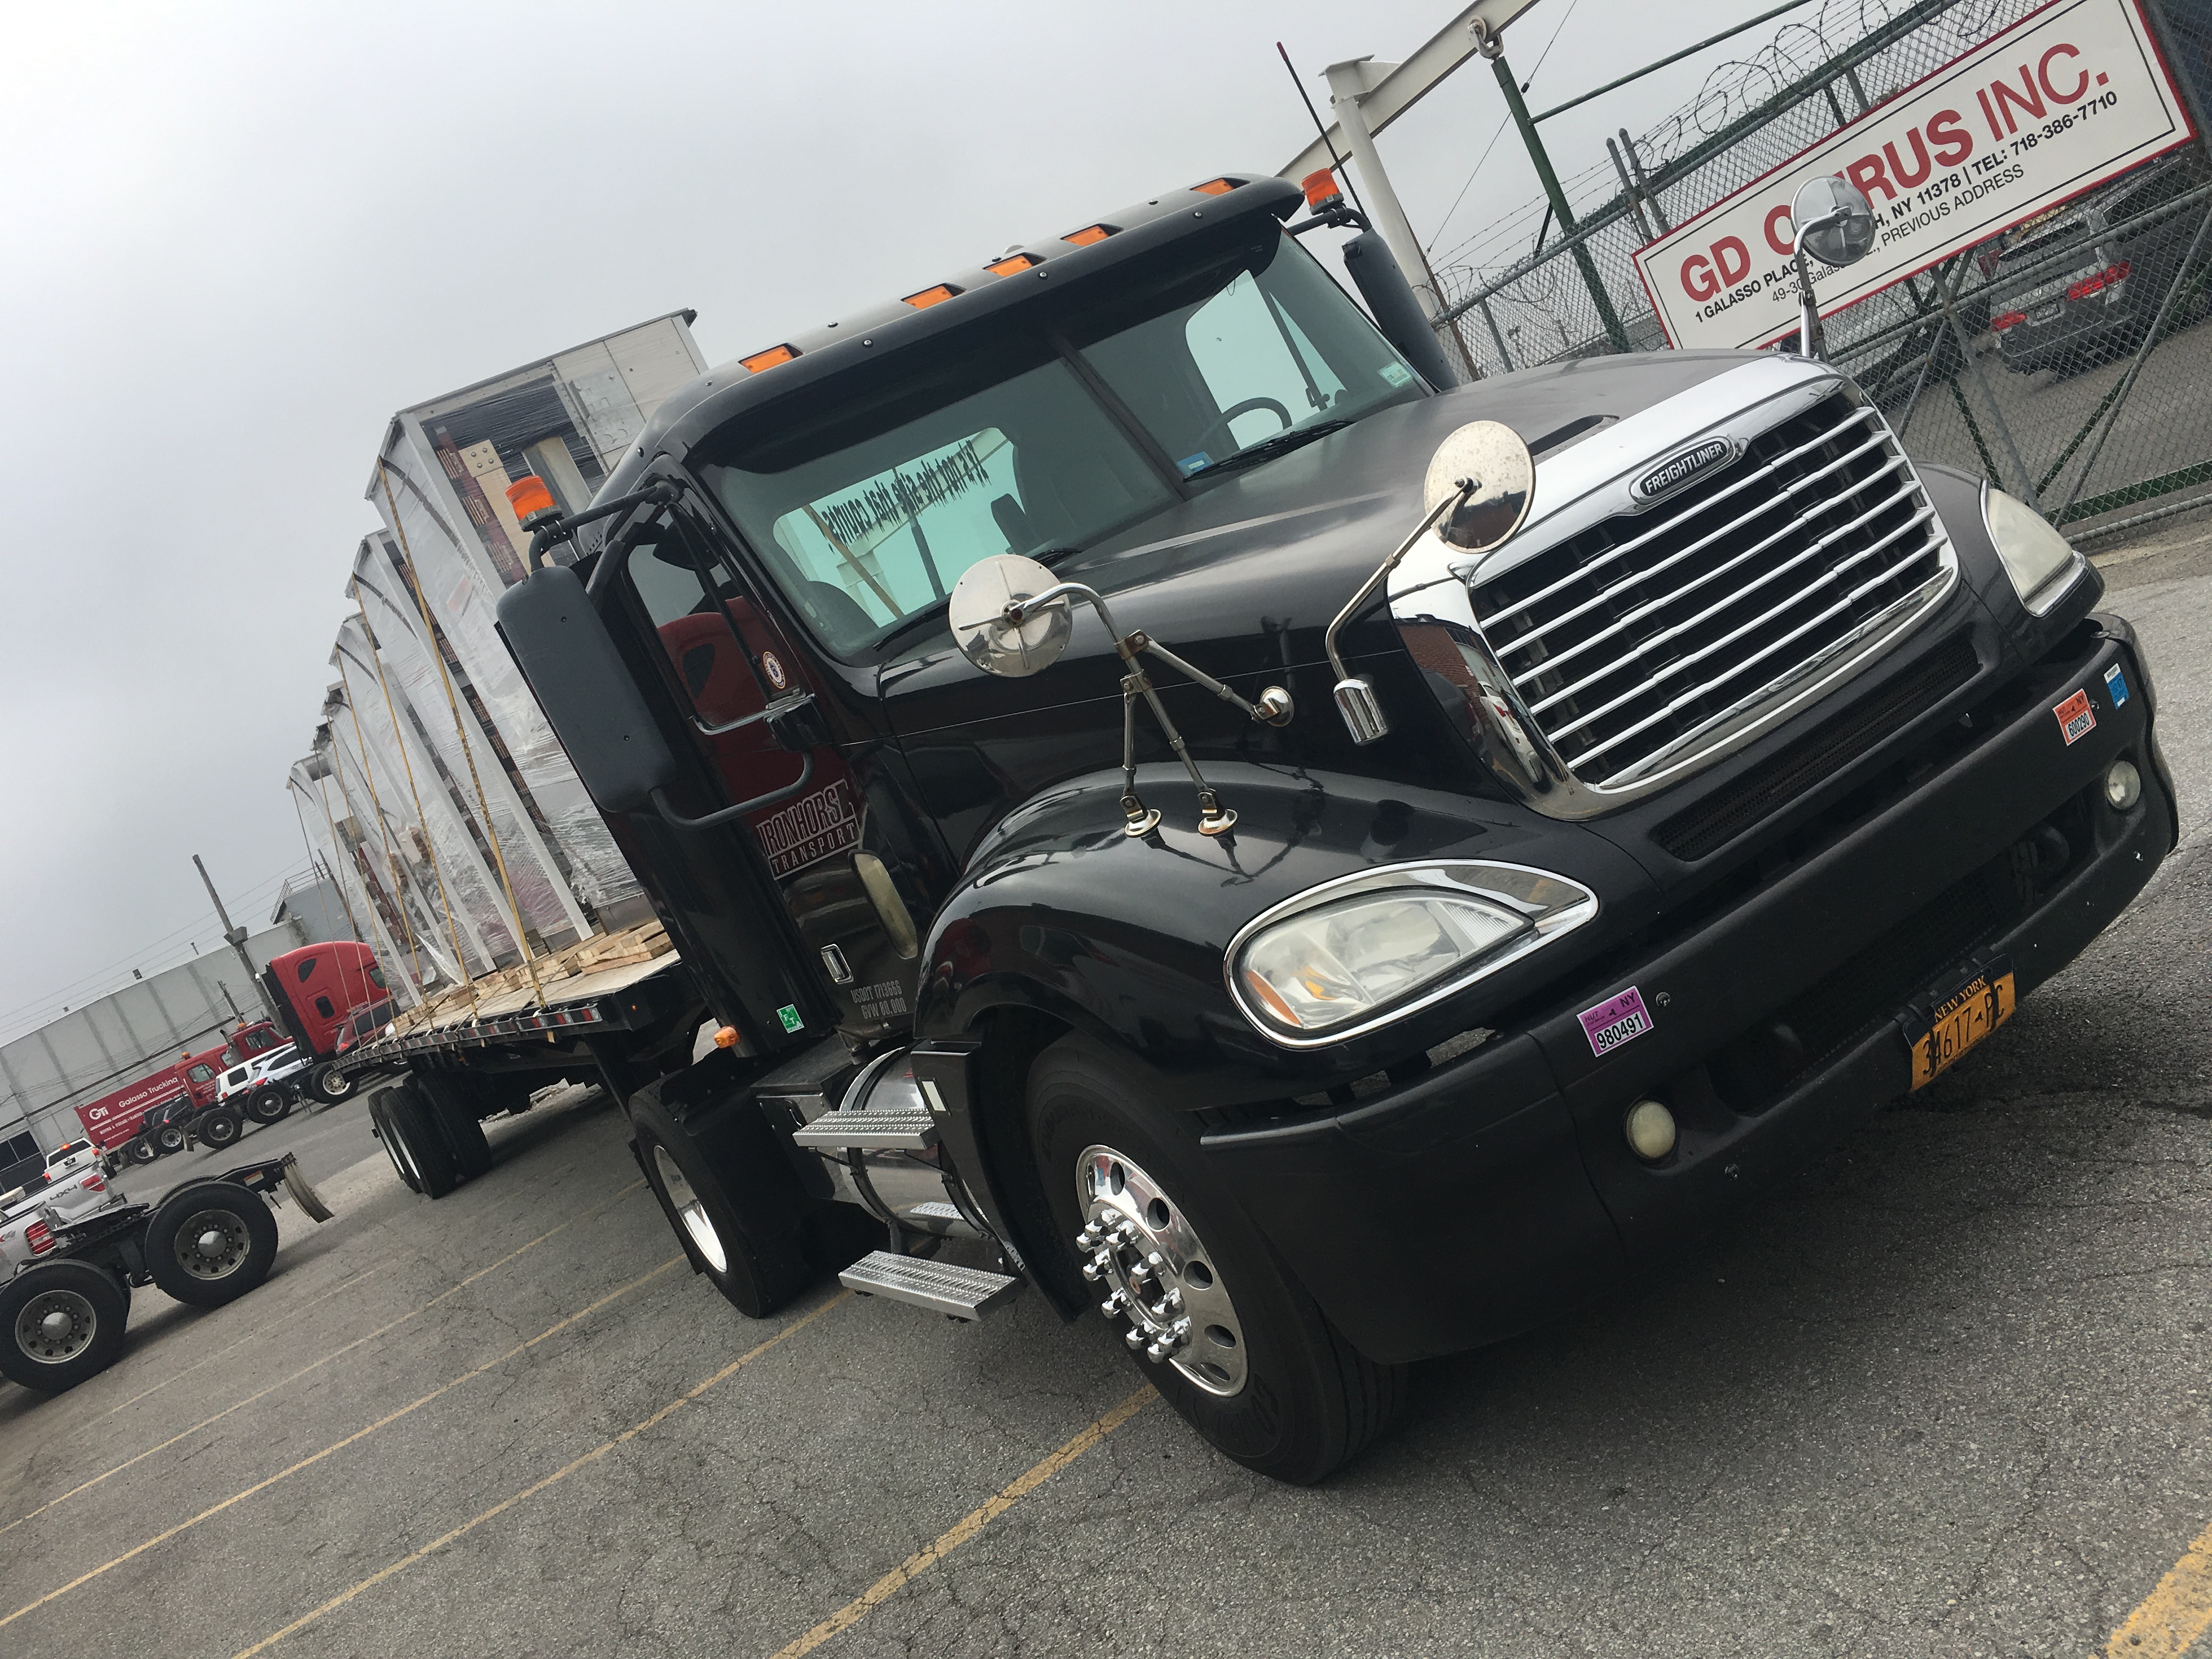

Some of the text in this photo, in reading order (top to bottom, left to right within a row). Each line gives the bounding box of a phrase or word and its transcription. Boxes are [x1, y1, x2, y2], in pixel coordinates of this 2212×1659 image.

[1680, 43, 2109, 302] GD CRUS INC.
[1891, 197, 1913, 219] NY
[1917, 173, 1961, 205] 11378
[1971, 149, 2008, 176] TEL:
[2010, 91, 2117, 156] 718-386-7710
[1881, 164, 2024, 246] PREVIOUS ADDRESS
[1695, 311, 1703, 323] 1
[1704, 280, 1761, 317] GALASSO
[1645, 443, 1724, 494] FREIGHTLINER
[2068, 713, 2090, 737] 600290
[757, 778, 856, 857] IRONHORSE
[772, 822, 855, 874] TRANSPORT
[850, 985, 874, 1003] USDOT
[861, 1002, 879, 1019] GVW
[1620, 992, 1635, 1008] NY
[1934, 975, 1987, 1022] NEW YORK
[1596, 1013, 1643, 1049] 980491
[119, 1091, 148, 1108] Galasso
